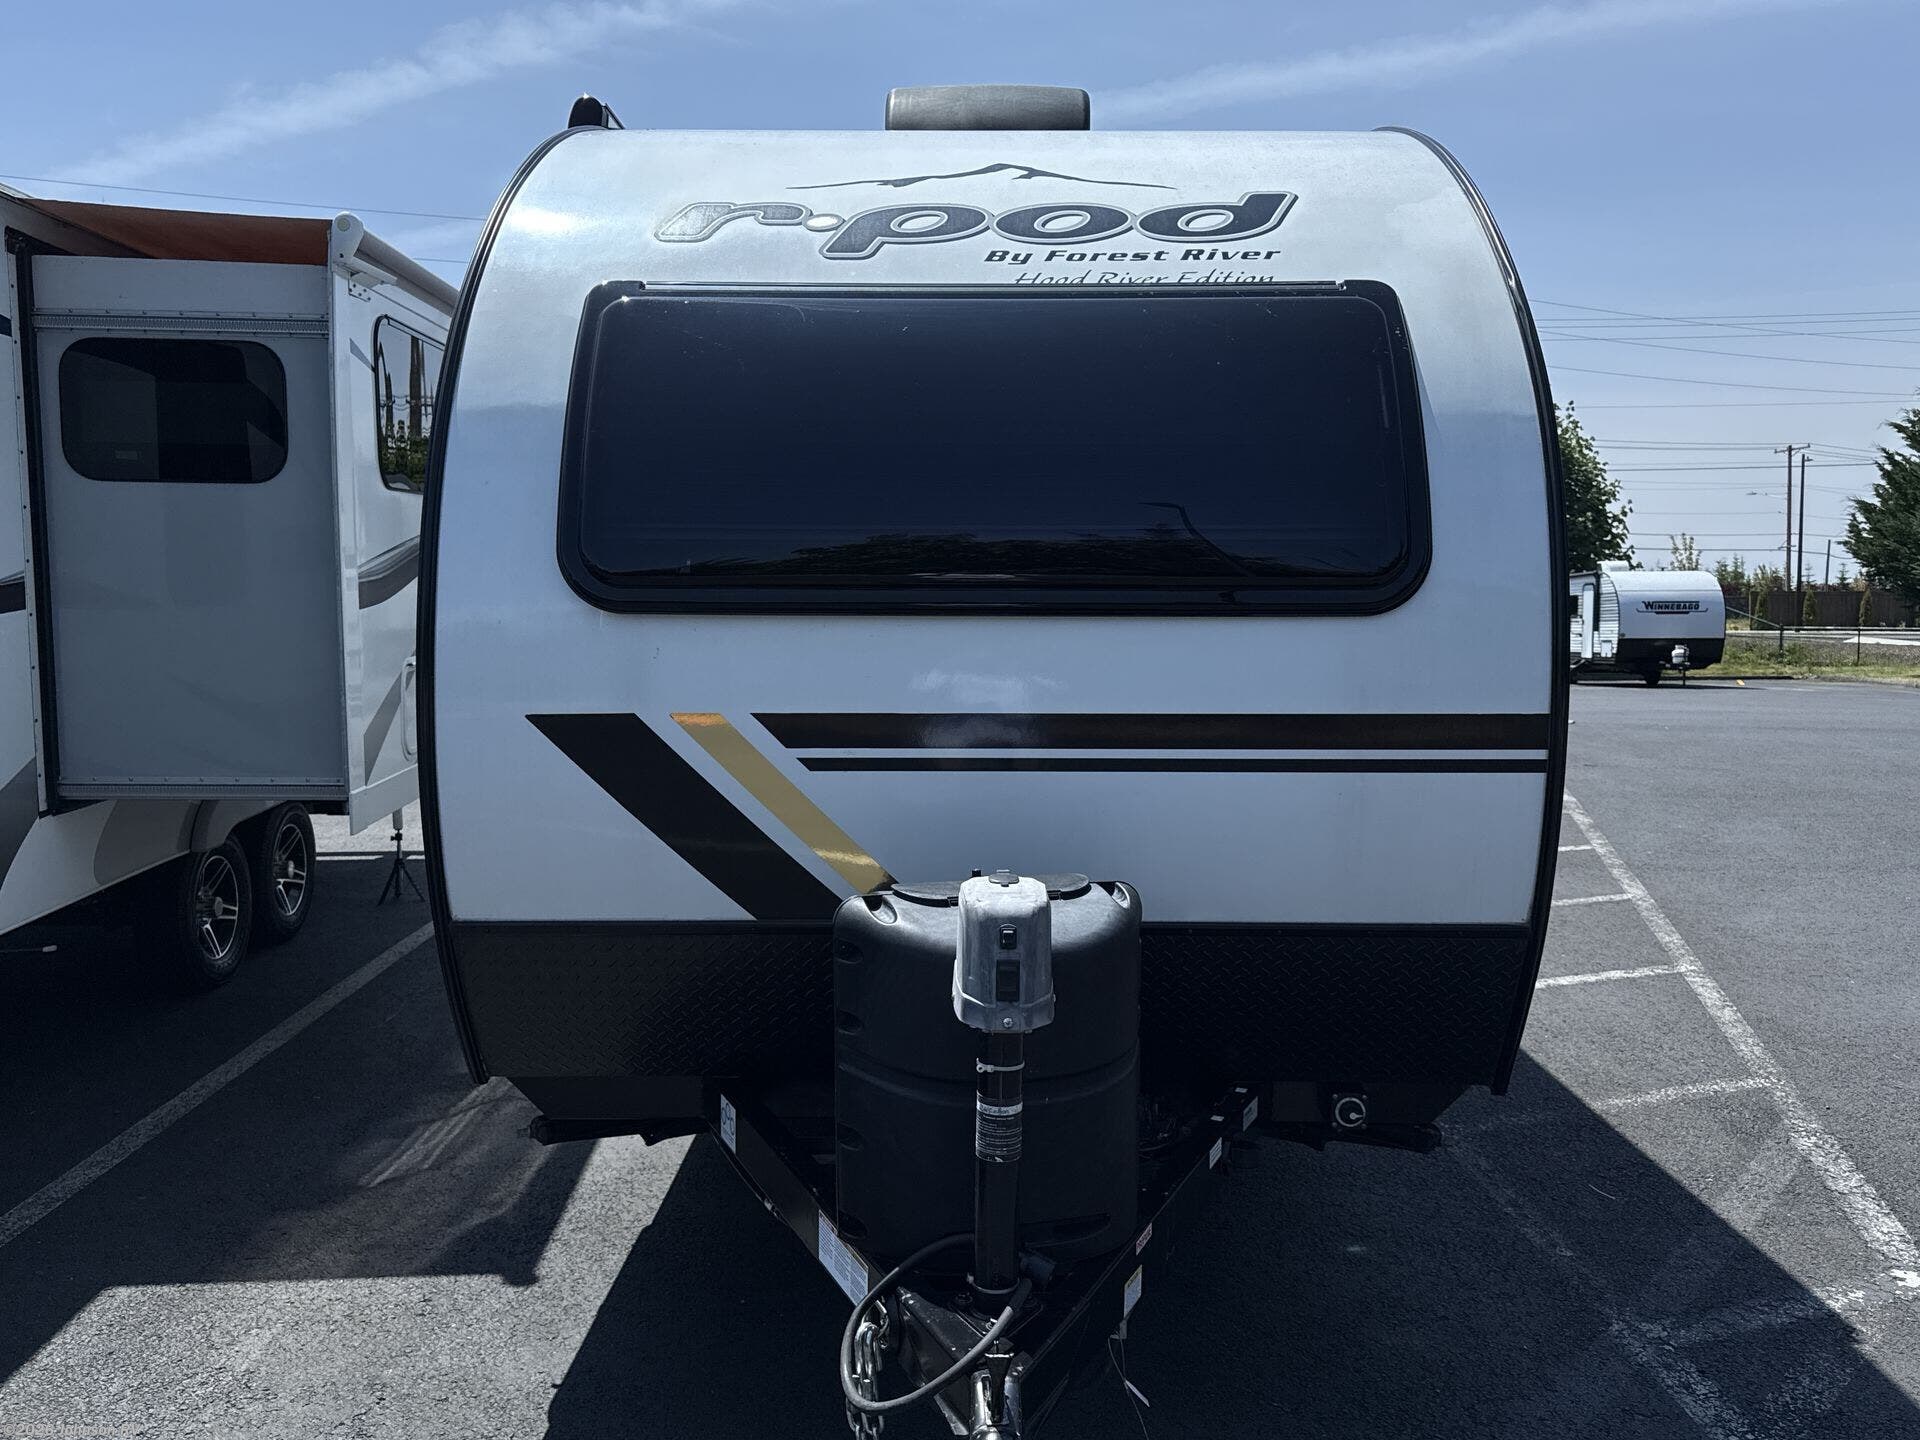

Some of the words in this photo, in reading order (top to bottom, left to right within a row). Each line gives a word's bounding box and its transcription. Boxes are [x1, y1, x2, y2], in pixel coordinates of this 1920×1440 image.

[984, 250, 1034, 265] By
[1044, 249, 1170, 262] Forest
[1180, 248, 1281, 261] River
[1098, 271, 1169, 284] River
[1176, 268, 1275, 284] Edition
